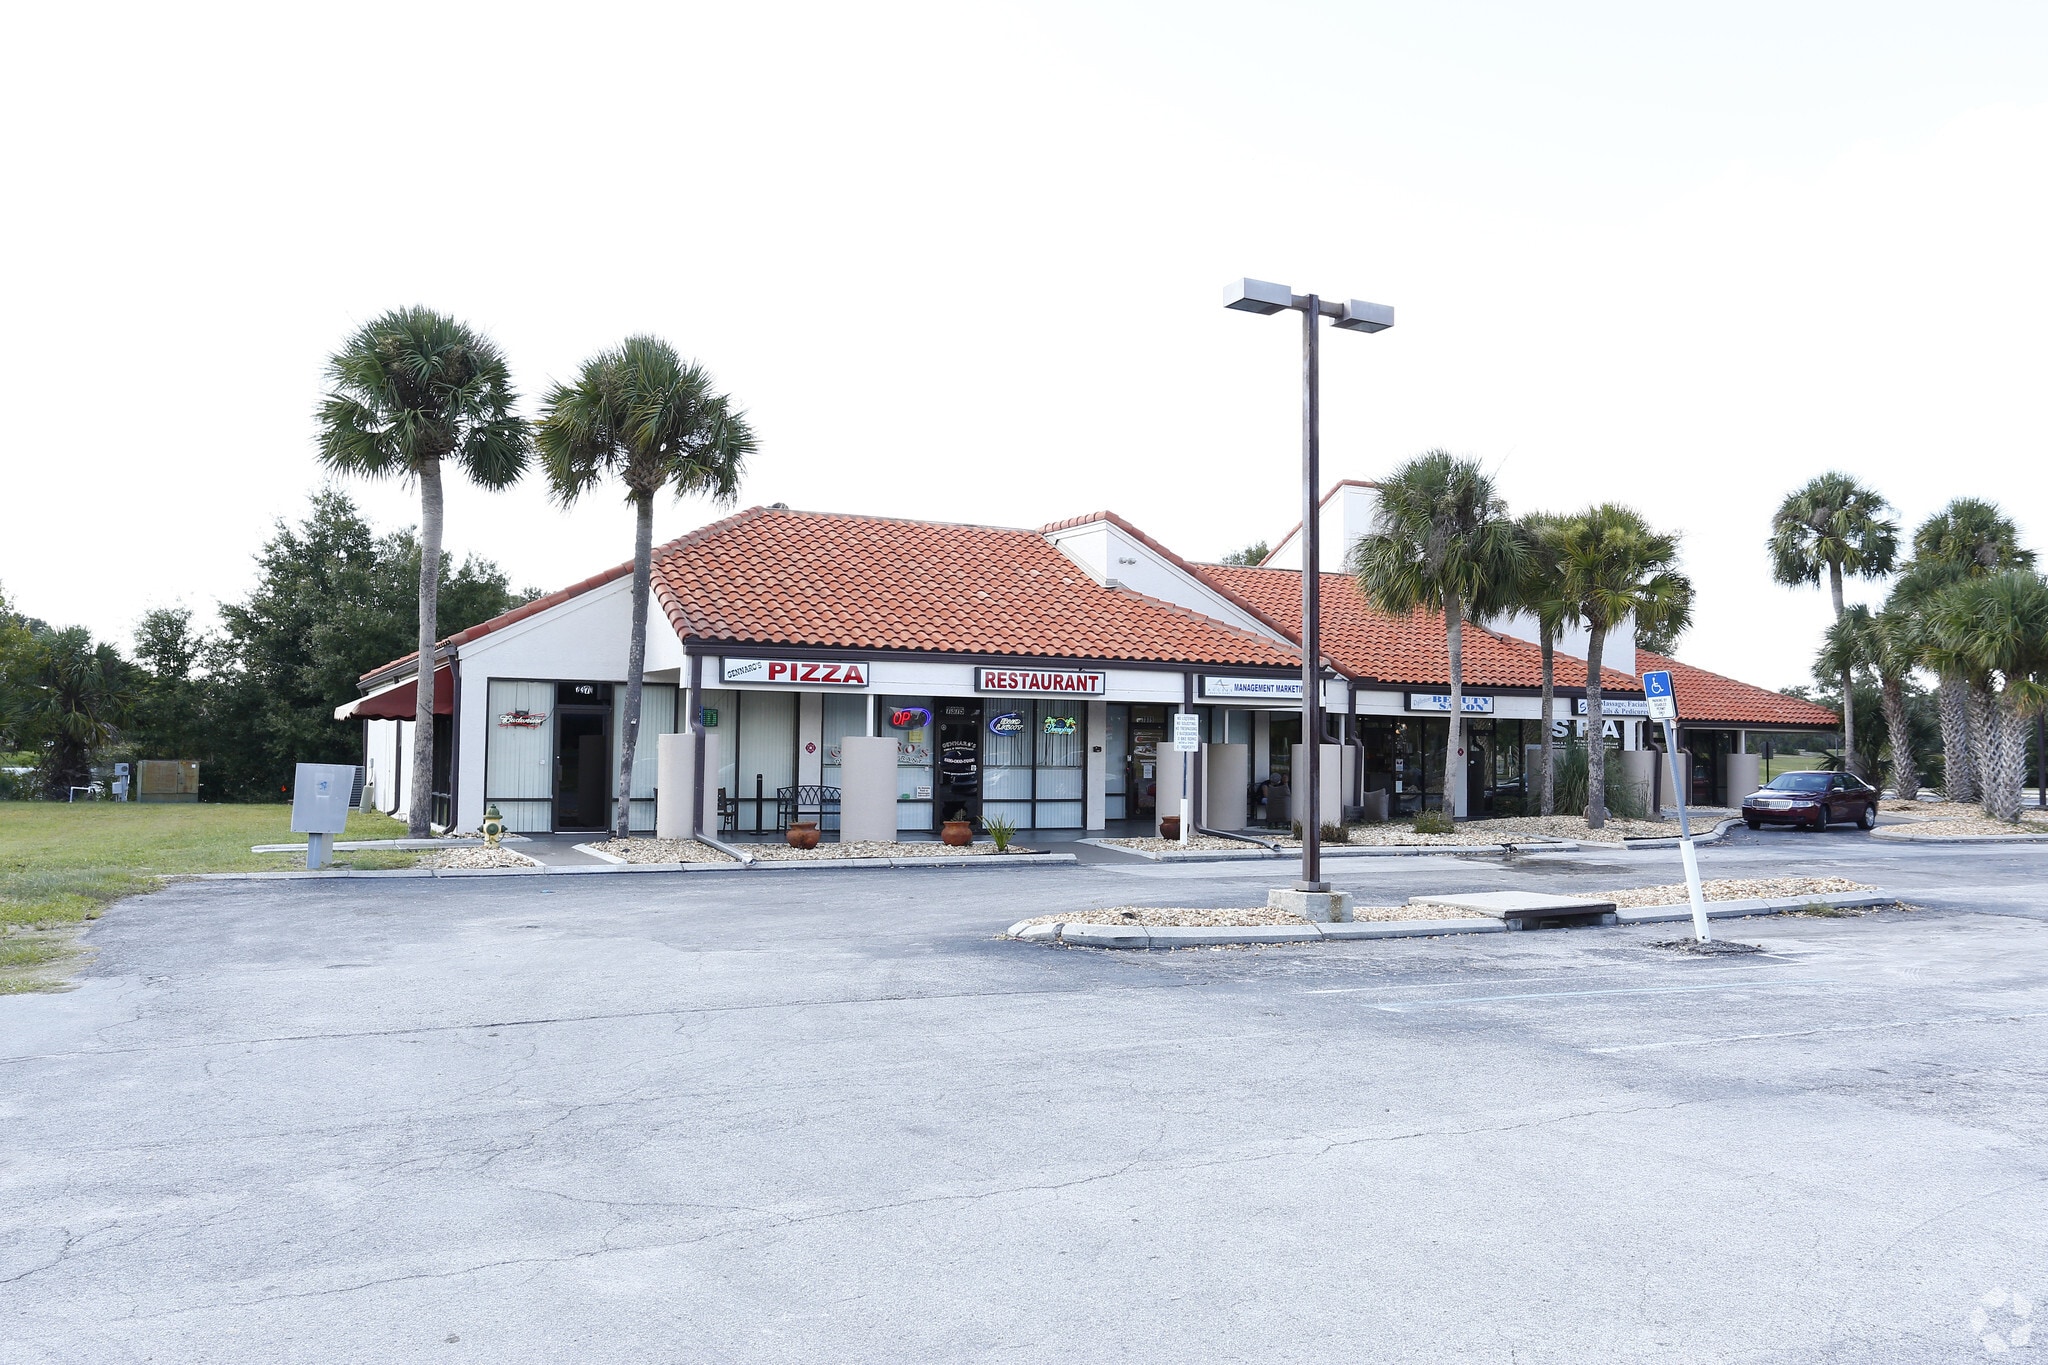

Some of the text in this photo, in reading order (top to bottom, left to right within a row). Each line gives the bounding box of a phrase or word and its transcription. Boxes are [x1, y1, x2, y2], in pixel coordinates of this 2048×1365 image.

[727, 662, 864, 683] GENNARO'S PIZZA
[985, 671, 1099, 691] RESTAURANT
[1234, 683, 1274, 693] MANAGEMENT
[1432, 696, 1489, 705] BEUTY
[1439, 703, 1484, 711] SAON
[1552, 720, 1620, 738] SPA
